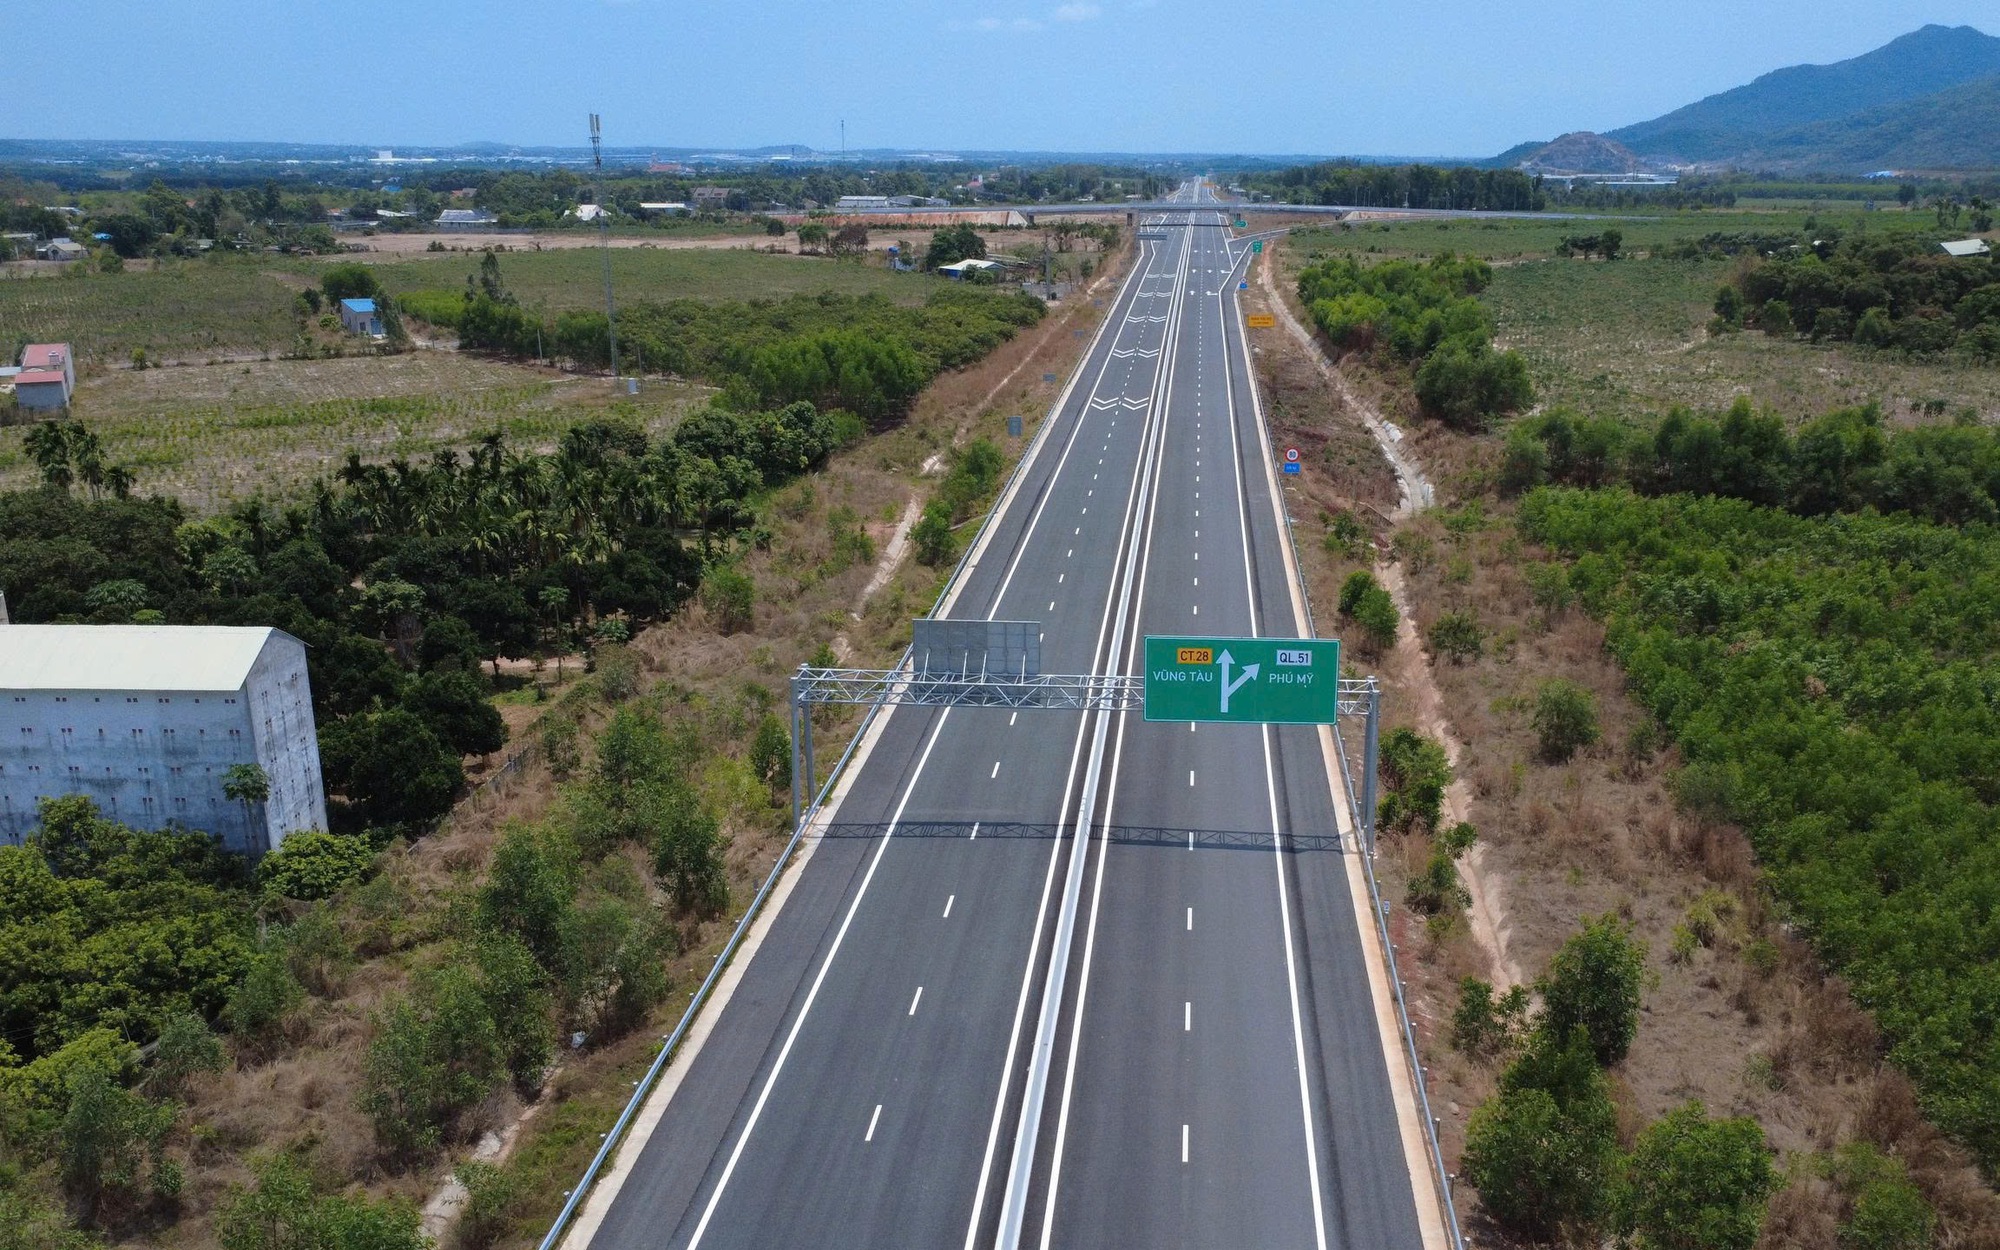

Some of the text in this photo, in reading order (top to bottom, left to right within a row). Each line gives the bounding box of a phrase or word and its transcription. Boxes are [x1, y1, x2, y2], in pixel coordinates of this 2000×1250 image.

[1180, 650, 1209, 662] CT.28
[1279, 652, 1310, 664] QL.51
[1153, 669, 1213, 682] VŨNG TÀU
[1269, 672, 1314, 688] PHÚ MỸ
